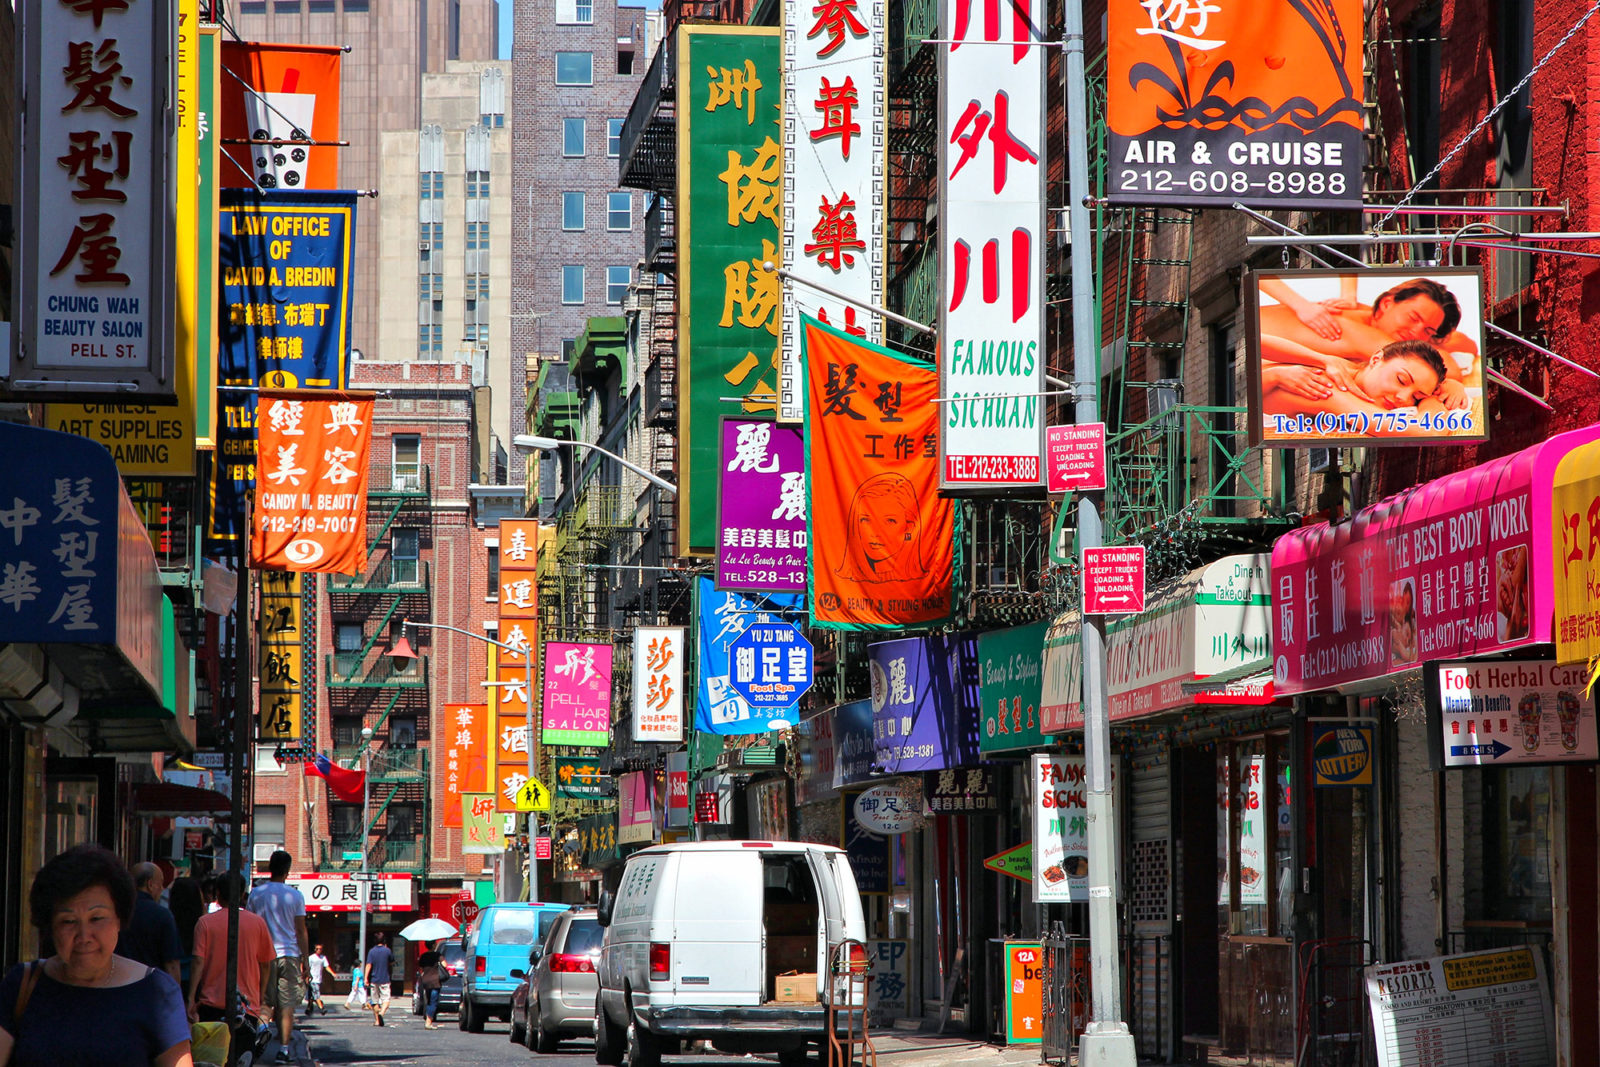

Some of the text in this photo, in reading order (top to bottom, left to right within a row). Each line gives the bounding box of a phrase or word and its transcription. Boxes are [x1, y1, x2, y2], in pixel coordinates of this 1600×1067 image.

[948, 0, 1040, 324] 川外川
[1123, 140, 1343, 166] AIR & CRUISE
[803, 0, 870, 336] 參茸藥
[1120, 169, 1346, 195] 212-608-8988
[231, 216, 330, 237] LAW OFFICE
[269, 240, 292, 260] OF
[224, 266, 336, 287] DAVID A. BREDIN
[48, 295, 139, 314] CHUNG WAH
[284, 303, 331, 327] 布瑞丁
[44, 319, 143, 338] BEAUTY SALON
[71, 343, 137, 359] PELL ST.
[951, 339, 1037, 377] FAMOUS
[267, 400, 364, 437] 經典
[949, 392, 1038, 430] SICHUAN
[59, 419, 183, 439] ART SUPPLIES
[1372, 411, 1474, 432] 775-4666
[1050, 429, 1101, 442] NO STANDING
[1052, 442, 1098, 453] EXCEPT TRUCKS
[1056, 453, 1085, 462] LOADING
[266, 442, 359, 487] 美容
[1056, 461, 1096, 471] UNLOADING
[261, 492, 359, 511] CANDY M. BEAUTY
[261, 516, 358, 533] 212-219-7007
[1386, 494, 1529, 573] THE BEST BODY WORK
[723, 527, 808, 549] 美容美髮中
[0, 497, 42, 613] 中華
[48, 477, 100, 631] 髮型屋
[724, 552, 803, 569] Lee Lee Beauty & Hair
[1087, 552, 1141, 564] NO STANDING
[1090, 565, 1138, 575] EXCEPT TRUCKS
[1093, 576, 1124, 584] LOADING
[1234, 564, 1263, 579] Dine in
[1094, 584, 1134, 593] UNLOADING
[1228, 575, 1234, 587] &
[821, 595, 838, 609] 12A
[1215, 585, 1252, 601] Take out
[847, 597, 874, 612] BEAUTY
[887, 599, 920, 612] STYLING
[750, 629, 794, 643] YU ZU TANG
[1419, 611, 1495, 653] Tel: (917) 775-4666
[1135, 624, 1183, 680] SICHUAN
[1212, 632, 1269, 662] 川外川
[736, 646, 808, 683] 御足堂
[1300, 635, 1385, 680] Tel: (212) 608-8988
[646, 635, 675, 712] 莎莎
[1445, 665, 1588, 690] Foot Herbal Care
[547, 681, 558, 690] 22
[749, 683, 796, 694] Foot Spa
[550, 692, 586, 710] PELL
[1445, 694, 1511, 715] Membership Benefits
[574, 707, 608, 720] HAIR
[455, 707, 474, 750] 華埠
[547, 719, 607, 731] SALON
[1336, 728, 1358, 739] NEW
[1339, 738, 1365, 754] YORK
[1470, 746, 1485, 755] Pell
[1486, 745, 1498, 754] St.
[1315, 751, 1367, 776] LOTTERY
[1048, 815, 1088, 838] 川外
[1017, 951, 1035, 963] 12A
[1377, 971, 1436, 994] RESORTS
